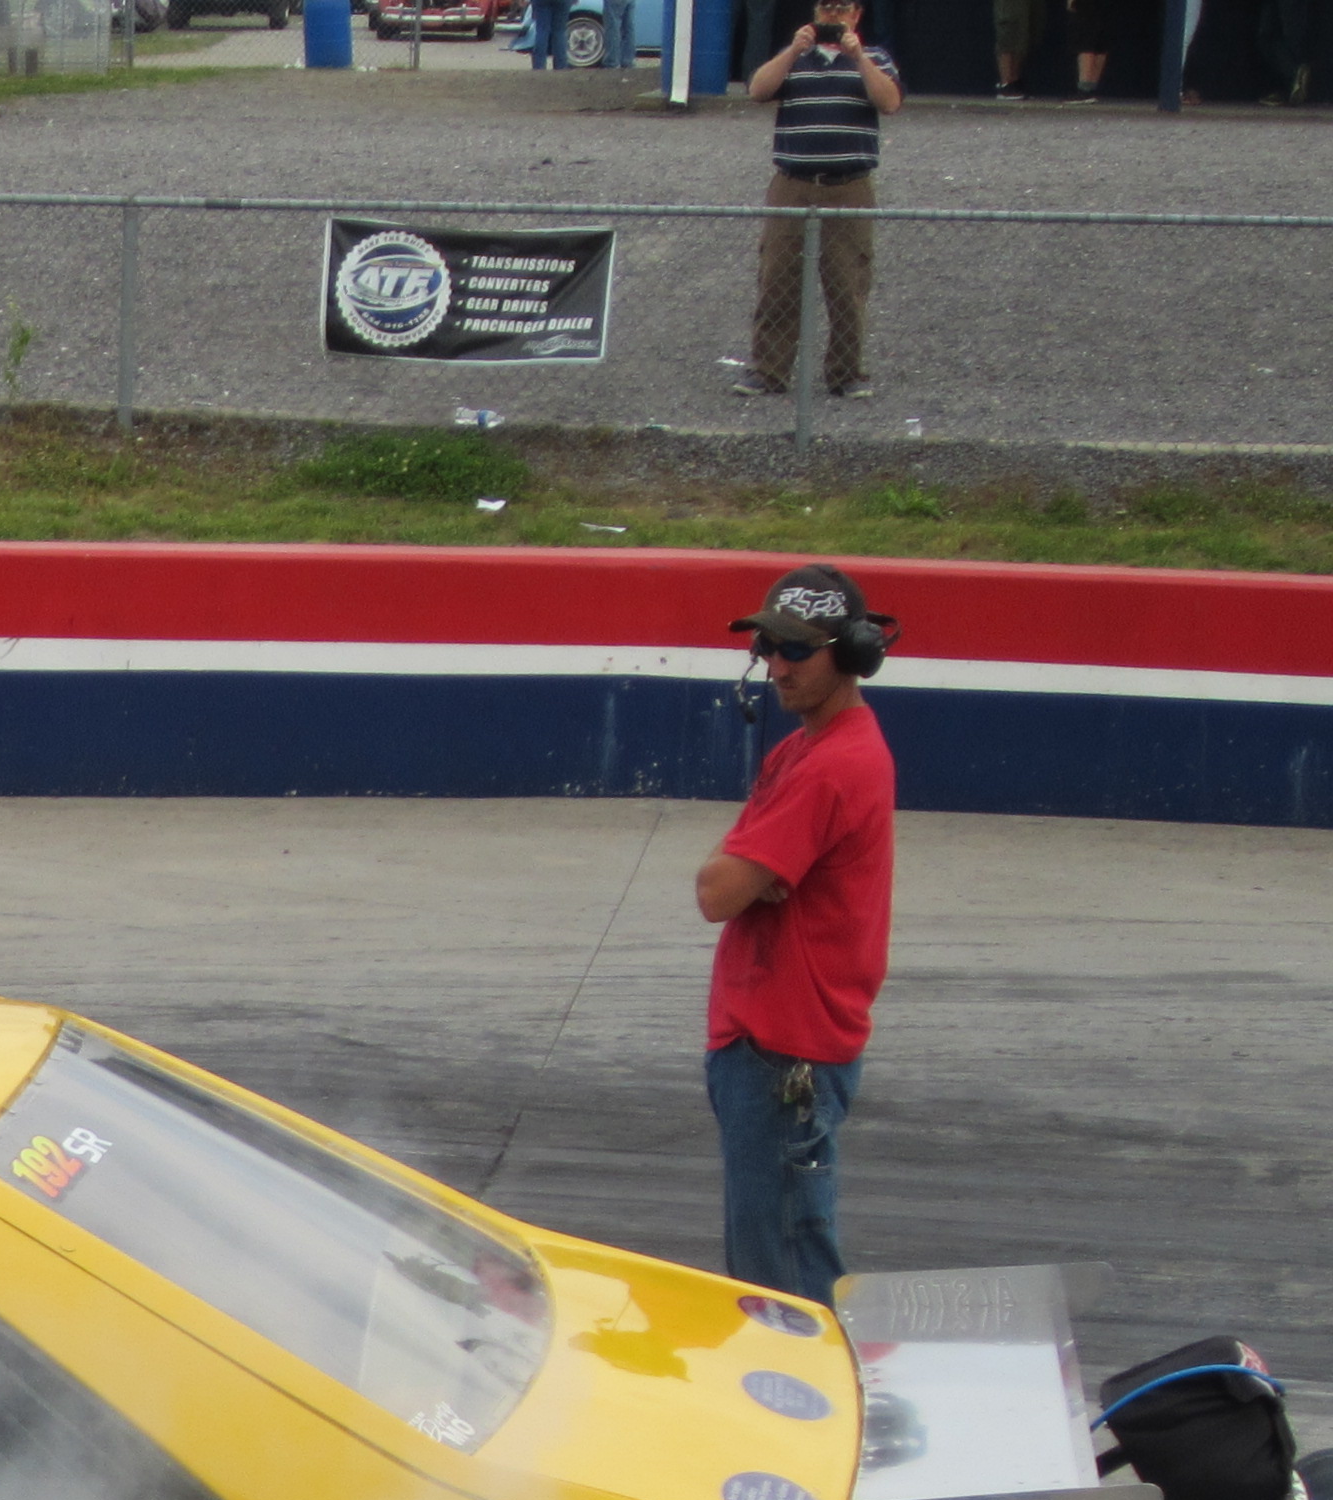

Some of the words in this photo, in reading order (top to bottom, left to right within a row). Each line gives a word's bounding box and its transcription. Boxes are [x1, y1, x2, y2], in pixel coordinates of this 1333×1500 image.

[471, 255, 576, 273] TRANSMISSIONS
[355, 265, 435, 299] ATF
[468, 276, 551, 293] CONVERTERS
[465, 297, 499, 310] GEAR
[501, 299, 549, 314] DRIVES
[463, 318, 547, 334] PROCHARGER
[547, 317, 594, 331] DEALER
[62, 1127, 113, 1164] SR
[12, 1135, 84, 1198] 192
